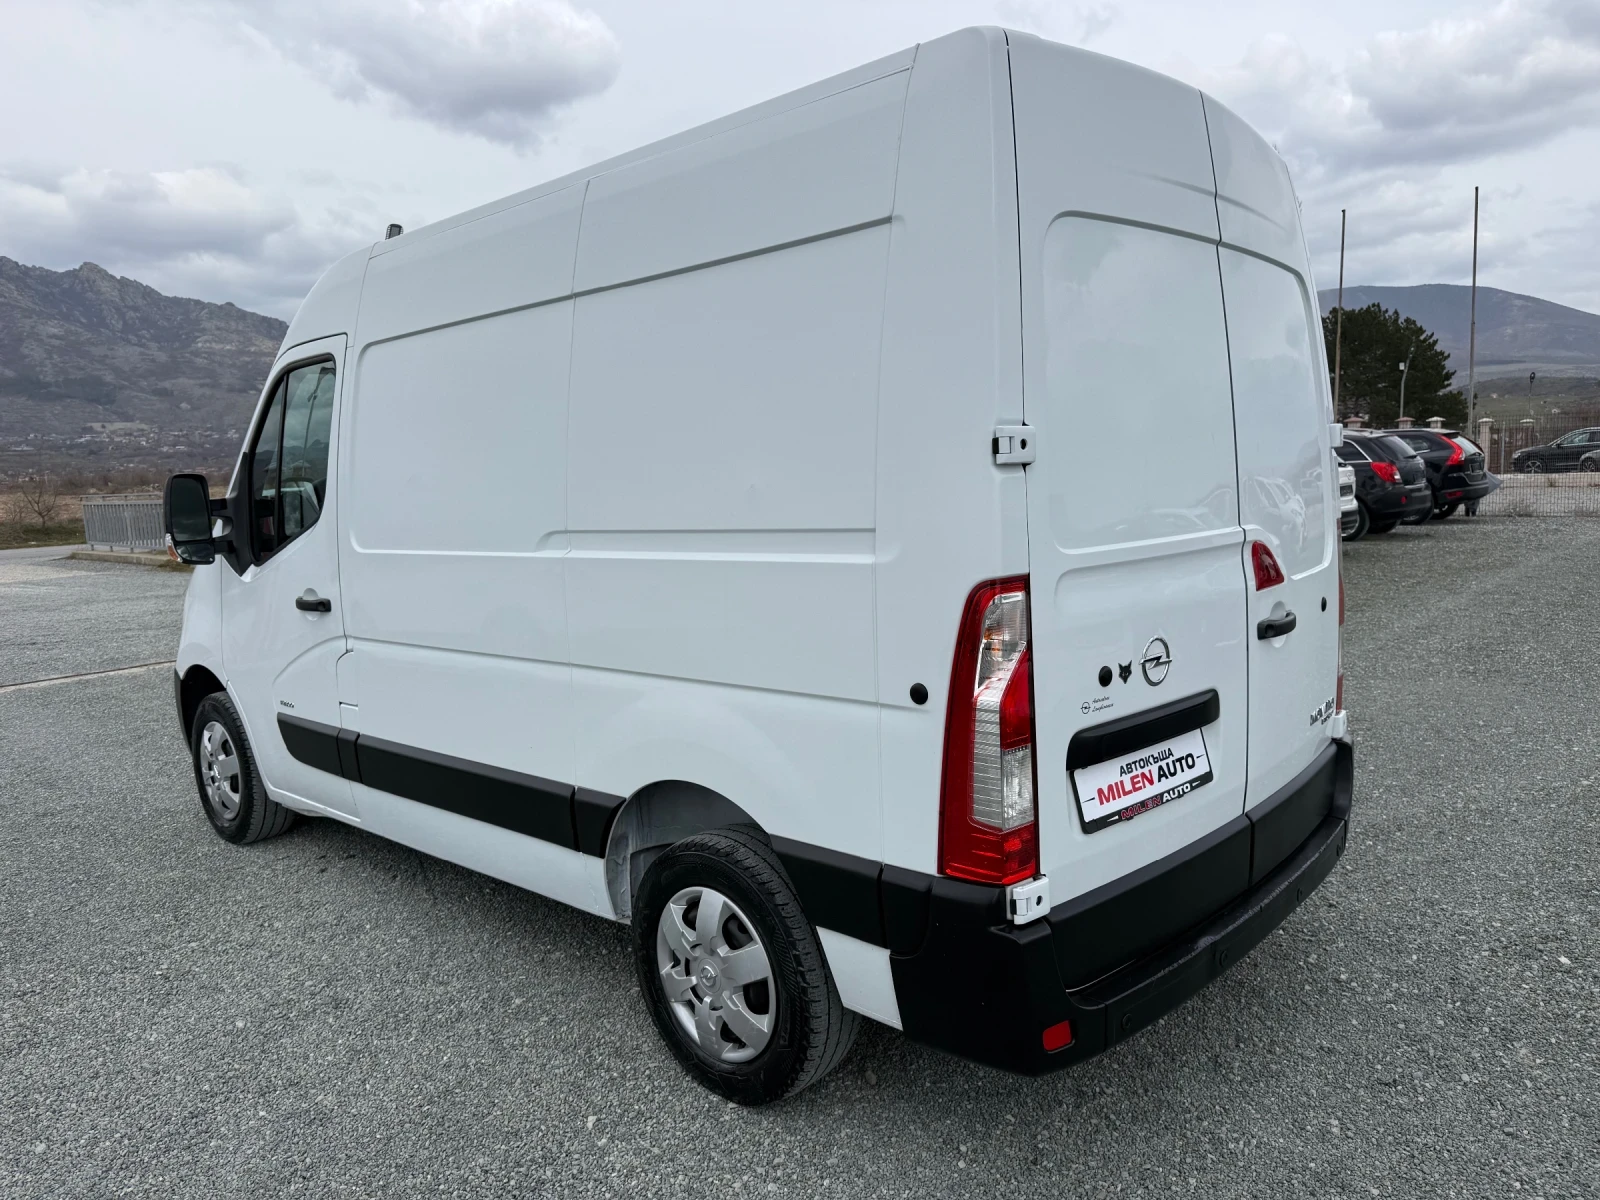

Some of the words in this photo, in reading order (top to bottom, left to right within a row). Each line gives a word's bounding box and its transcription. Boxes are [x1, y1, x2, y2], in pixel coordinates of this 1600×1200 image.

[1096, 769, 1155, 805] MILEN
[1157, 752, 1196, 783] AUTO
[1119, 747, 1175, 777] АВТОКЪША
[1120, 795, 1162, 820] MILEN
[1162, 782, 1191, 803] AUTO
